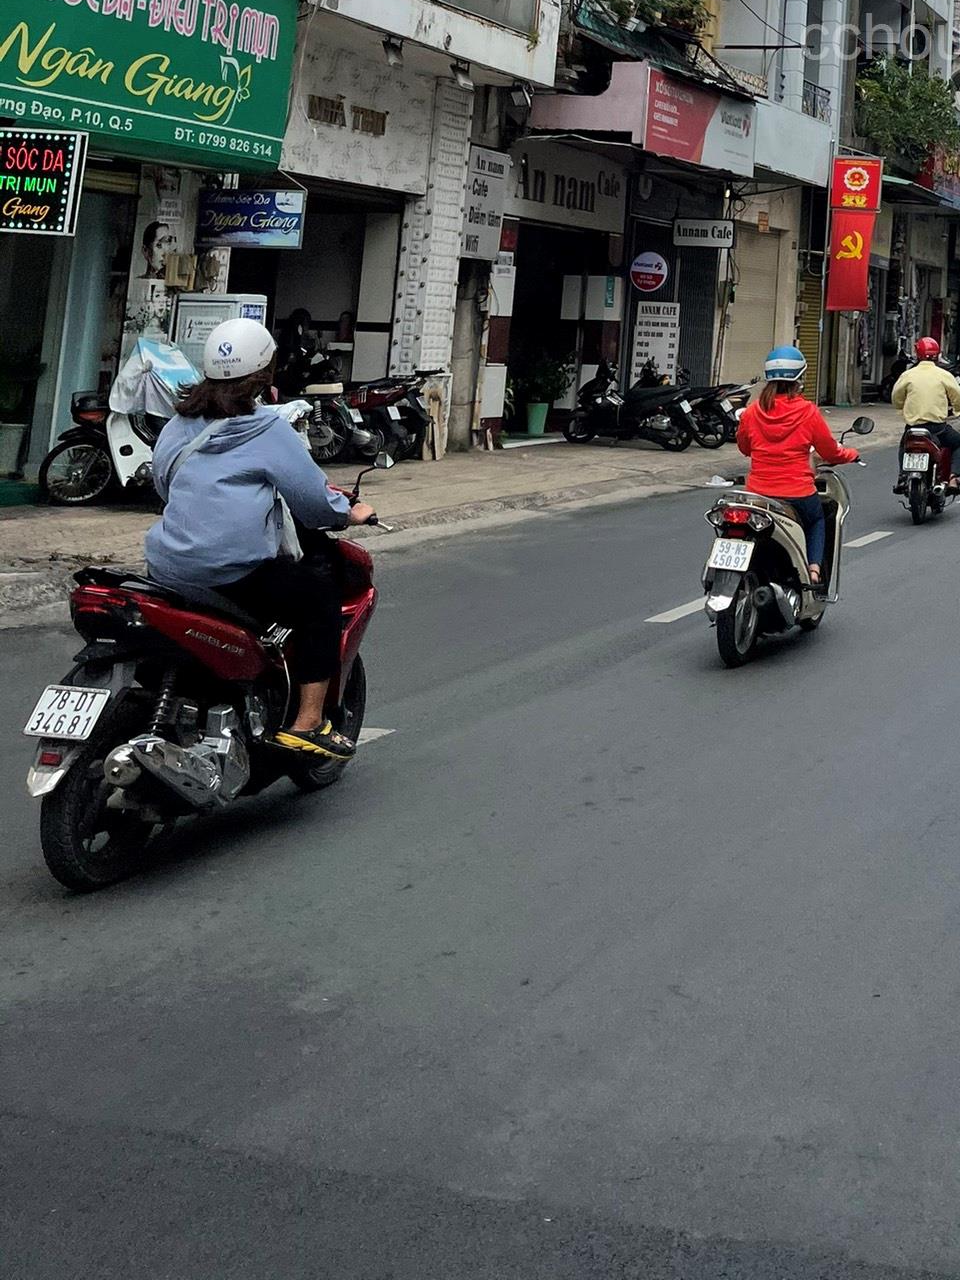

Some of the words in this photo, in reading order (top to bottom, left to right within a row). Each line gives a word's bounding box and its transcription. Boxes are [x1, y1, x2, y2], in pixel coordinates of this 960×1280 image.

[237, 6, 280, 63] MỤN
[0, 21, 115, 88] Ngân
[124, 53, 238, 122] Giang
[31, 100, 66, 121] Đạo,
[70, 108, 104, 129] P.10,
[108, 115, 134, 132] Q.5
[174, 126, 195, 144] ĐT:
[198, 131, 227, 149] 0799
[229, 136, 250, 153] 826
[252, 140, 273, 157] 514
[5, 141, 39, 171] SÓC
[42, 149, 64, 172] DA
[23, 177, 57, 196] MỤN
[514, 152, 546, 204] An
[551, 174, 596, 213] nam
[2, 196, 51, 222] Giang
[250, 209, 299, 234] Giang
[676, 223, 709, 239] Annam
[711, 225, 732, 240] Cafe
[47, 688, 98, 713] 78-D1
[30, 711, 92, 736] 346.81
